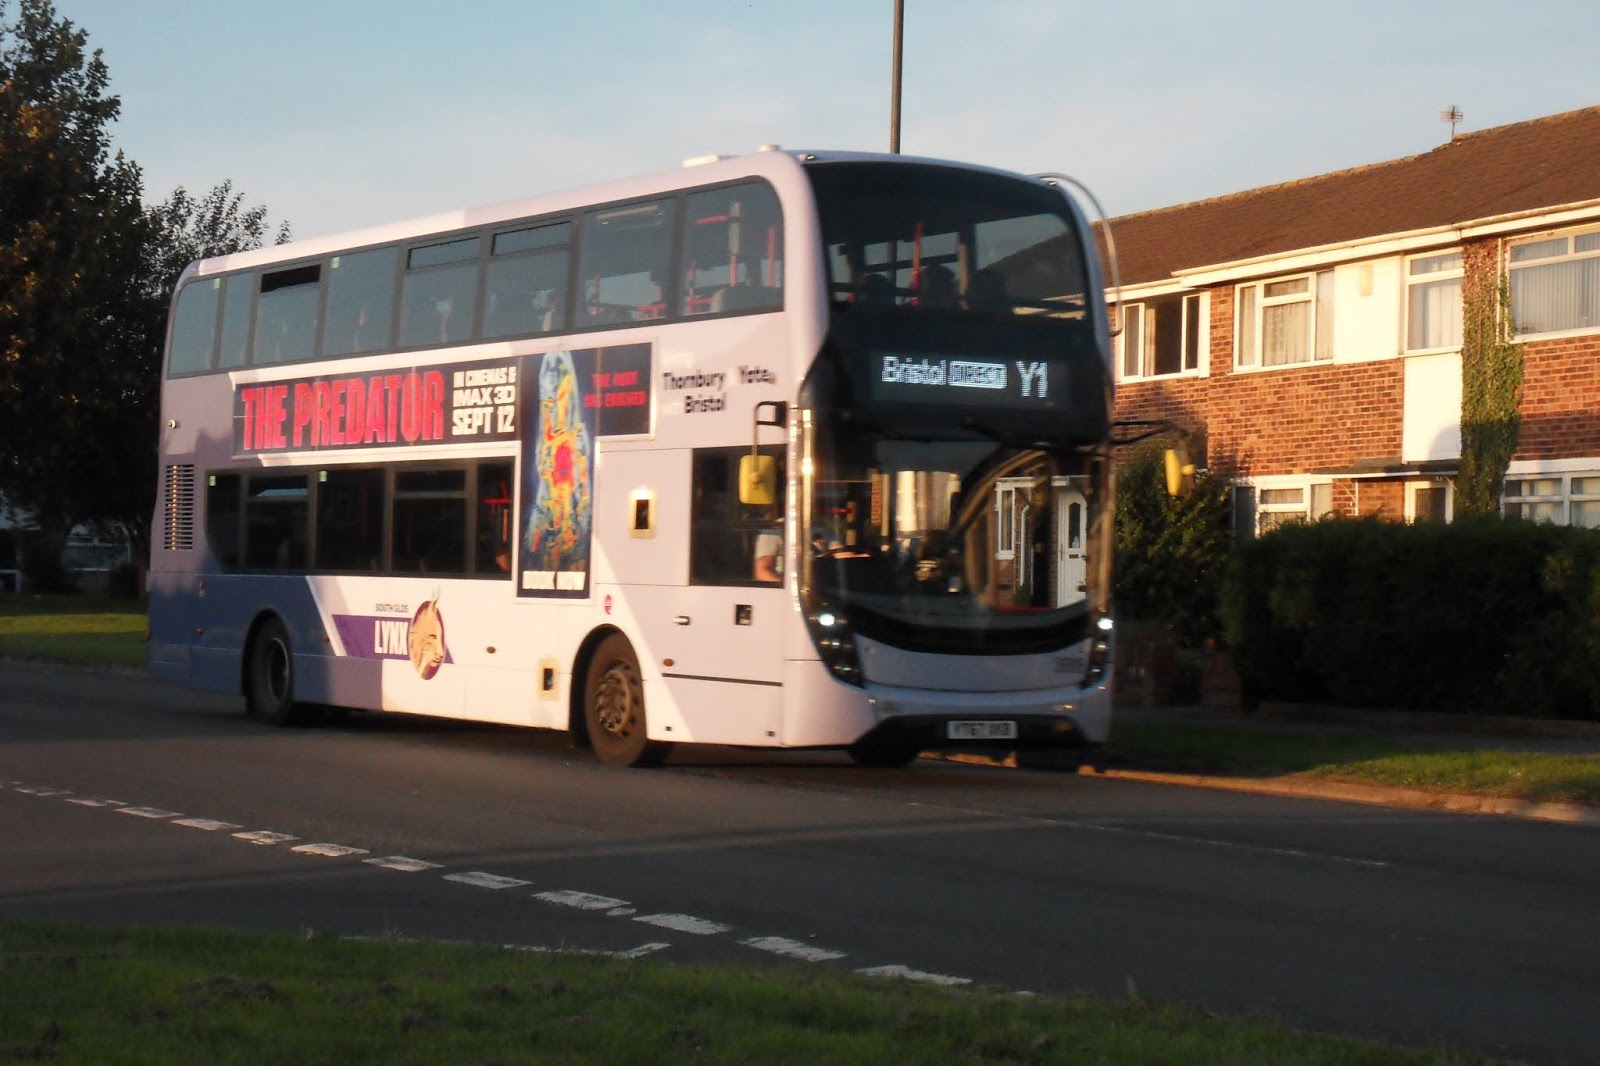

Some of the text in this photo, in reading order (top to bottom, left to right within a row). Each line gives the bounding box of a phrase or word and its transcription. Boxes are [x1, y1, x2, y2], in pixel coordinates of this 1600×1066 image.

[661, 368, 726, 392] Thornbury
[881, 355, 947, 386] Bristol
[1015, 360, 1048, 398] Y1
[242, 370, 445, 450] THE PREDATOR
[493, 385, 516, 405] 3D
[684, 391, 728, 414] Bristol
[452, 404, 515, 436] SEPT 12
[374, 620, 409, 656] LYNX
